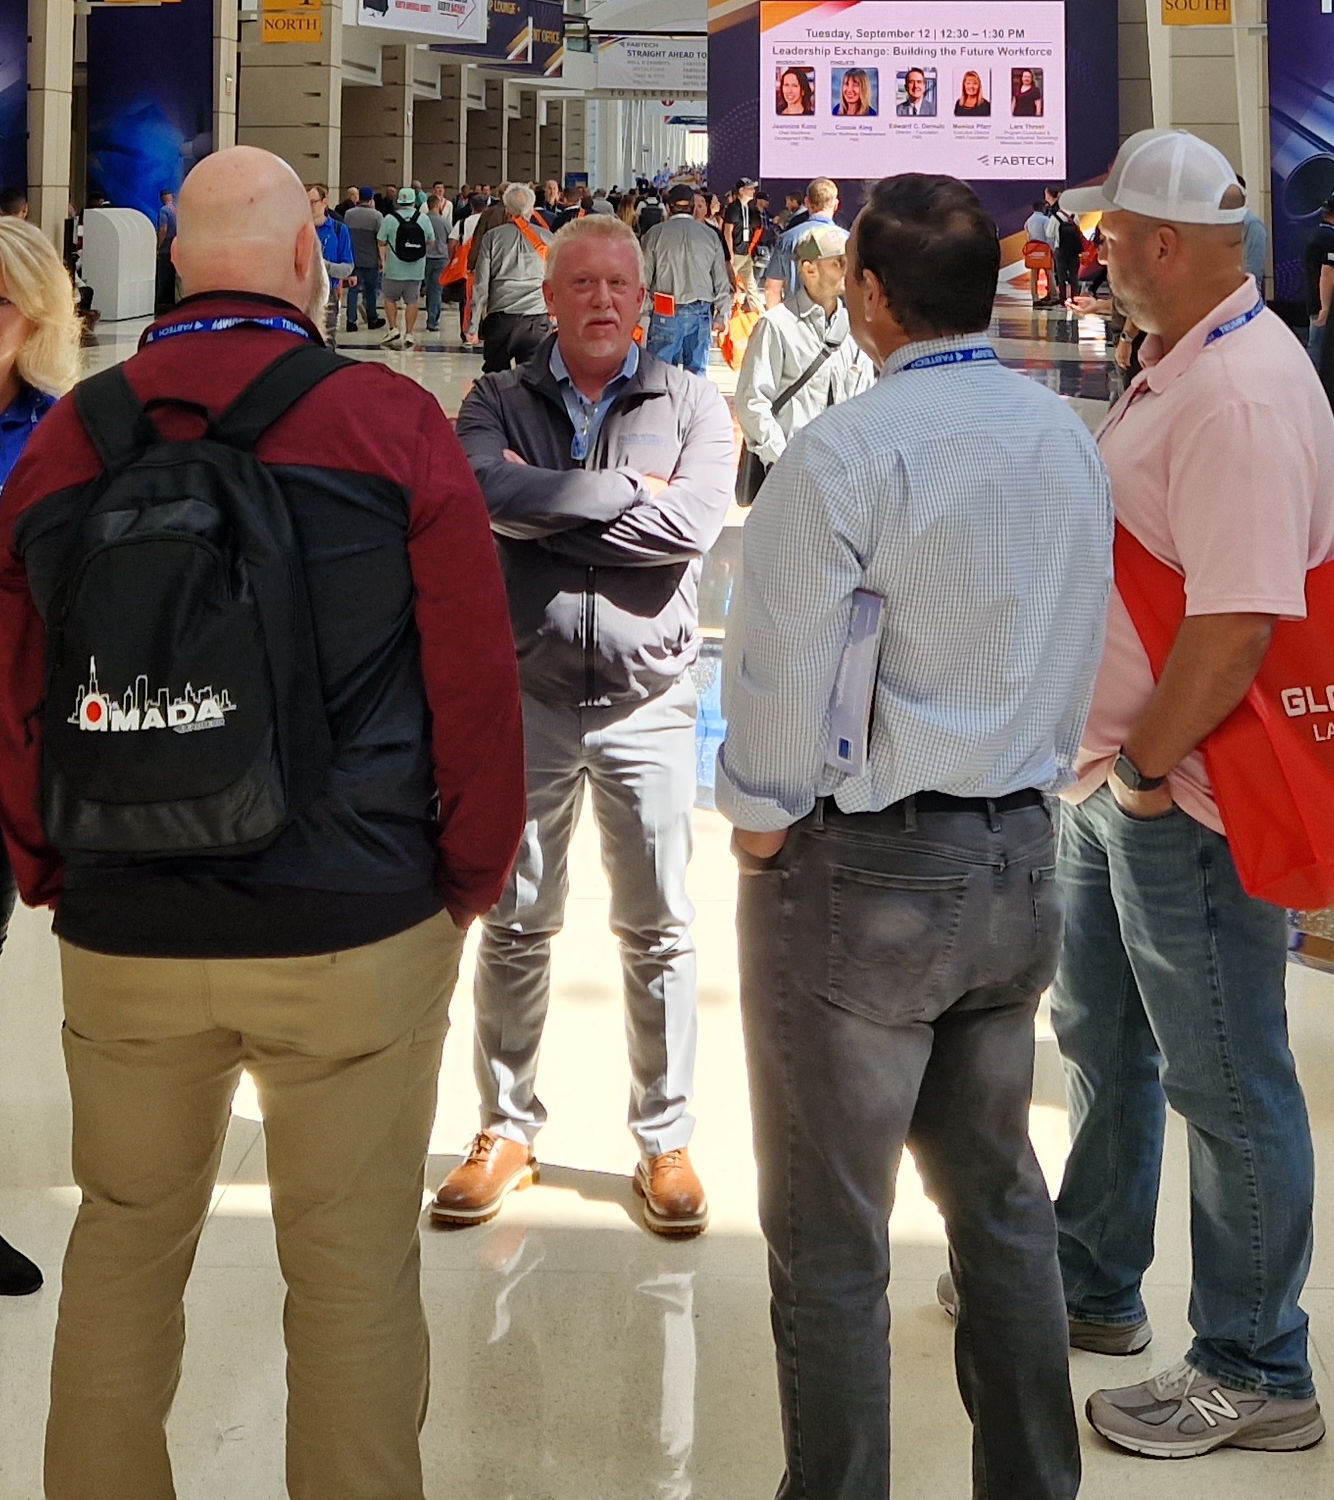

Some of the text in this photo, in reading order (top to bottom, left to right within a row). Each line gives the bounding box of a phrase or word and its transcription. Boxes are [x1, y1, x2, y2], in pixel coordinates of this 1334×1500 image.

[262, 17, 319, 33] NORTH
[806, 28, 853, 40] Tuesday,
[856, 28, 915, 40] September
[919, 29, 931, 38] 12
[940, 29, 968, 38] 12:30
[982, 29, 1004, 38] 1:30
[1008, 29, 1025, 38] PM
[627, 49, 666, 58] STRAIGHT
[668, 51, 695, 59] AHEAD
[772, 46, 1053, 58] Leadership Exchange: Building the Future Workforce
[610, 89, 697, 98] TO LAKESIDE
[993, 156, 1055, 166] FABTECH
[1188, 1387, 1240, 1428] N
